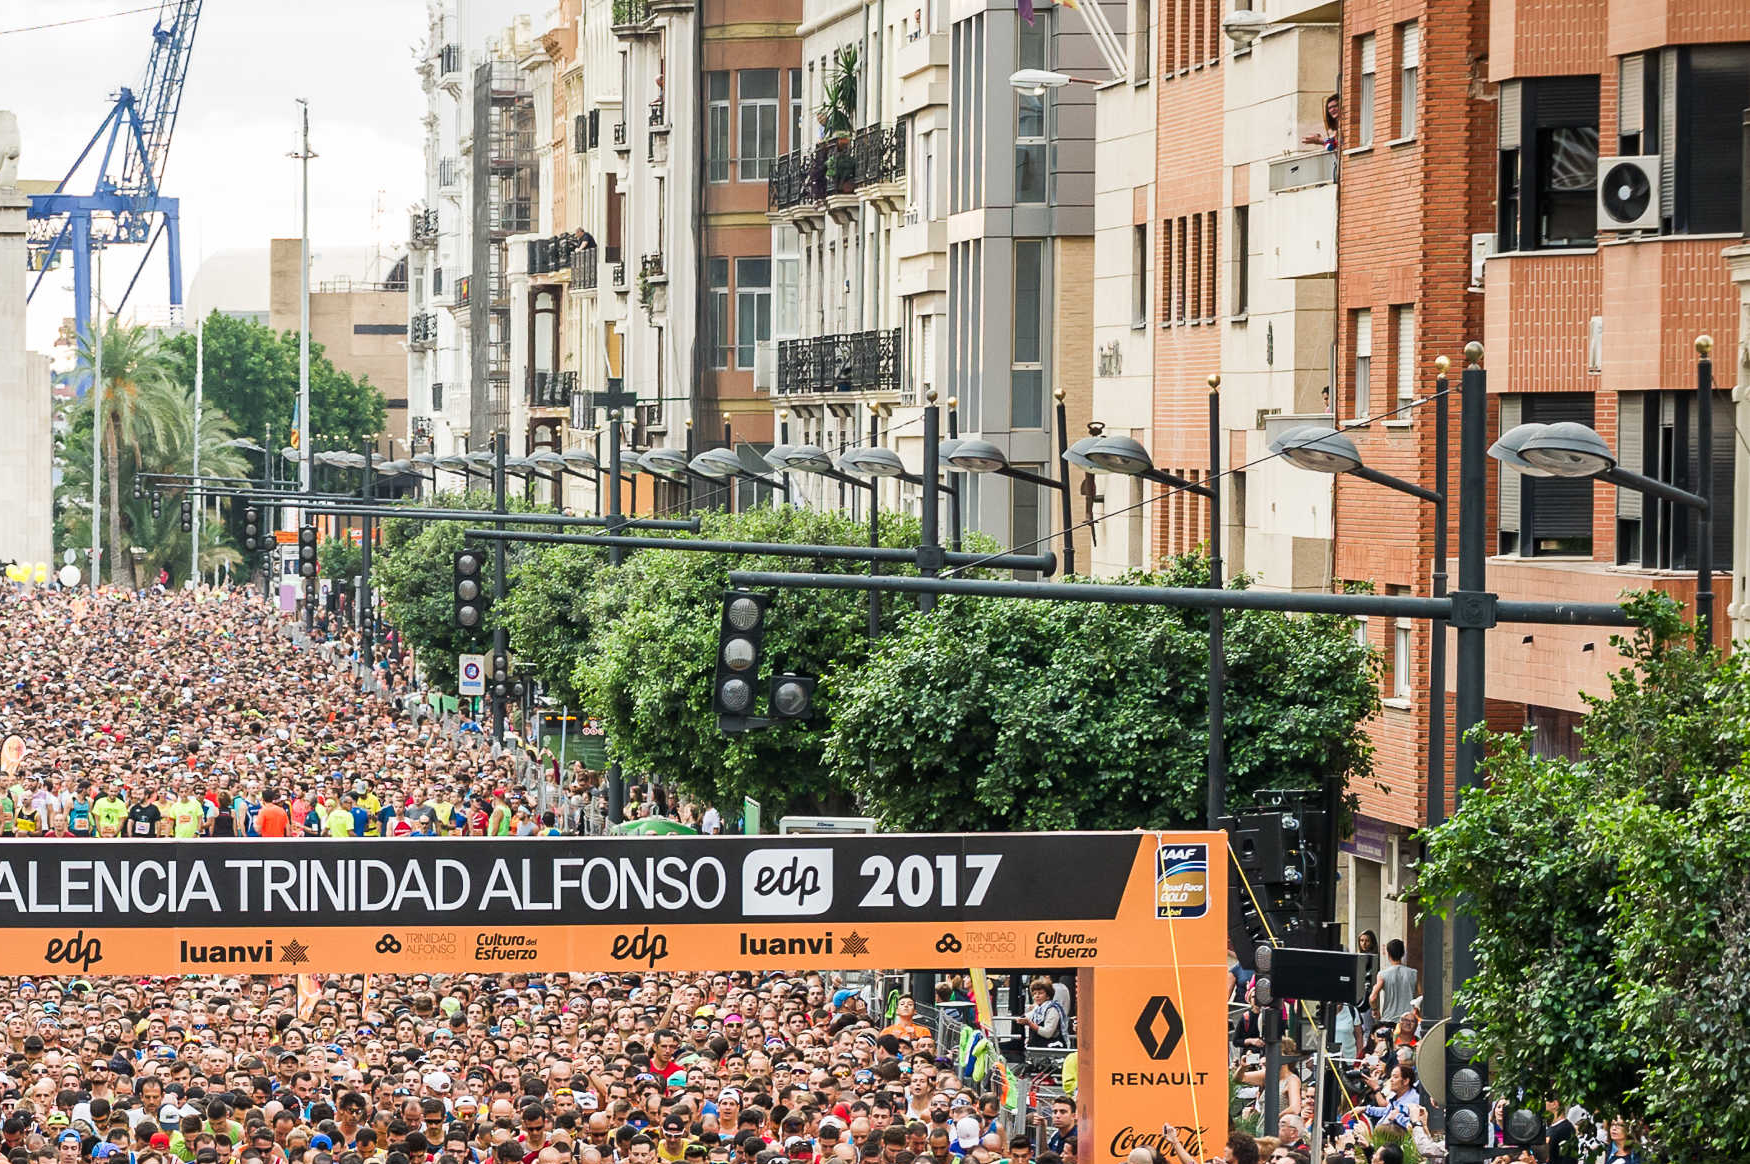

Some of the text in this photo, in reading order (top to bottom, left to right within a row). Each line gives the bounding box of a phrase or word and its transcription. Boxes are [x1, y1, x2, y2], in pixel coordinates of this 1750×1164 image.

[1162, 848, 1197, 860] IAAF
[225, 857, 471, 913] TRINIDAD
[479, 857, 727, 912] ALFONSO
[754, 855, 822, 907] edp
[857, 854, 1003, 908] 2017
[1183, 882, 1204, 892] Race
[1161, 892, 1189, 903] GOLD
[405, 932, 456, 943] TRINIDAD
[476, 933, 525, 946] Cultura
[965, 931, 1016, 942] TRINIDAD
[1036, 931, 1098, 944] Cultura del
[405, 944, 456, 954] ALFONSO
[611, 926, 669, 968] edp
[740, 932, 833, 955] luanvi
[965, 942, 1016, 953] ALFONSO
[45, 929, 103, 972] edp
[180, 939, 273, 963] luanvi
[475, 946, 538, 960] Esfuerzo
[1035, 945, 1098, 959] Esfuerzo
[1111, 1072, 1209, 1086] RENAULT
